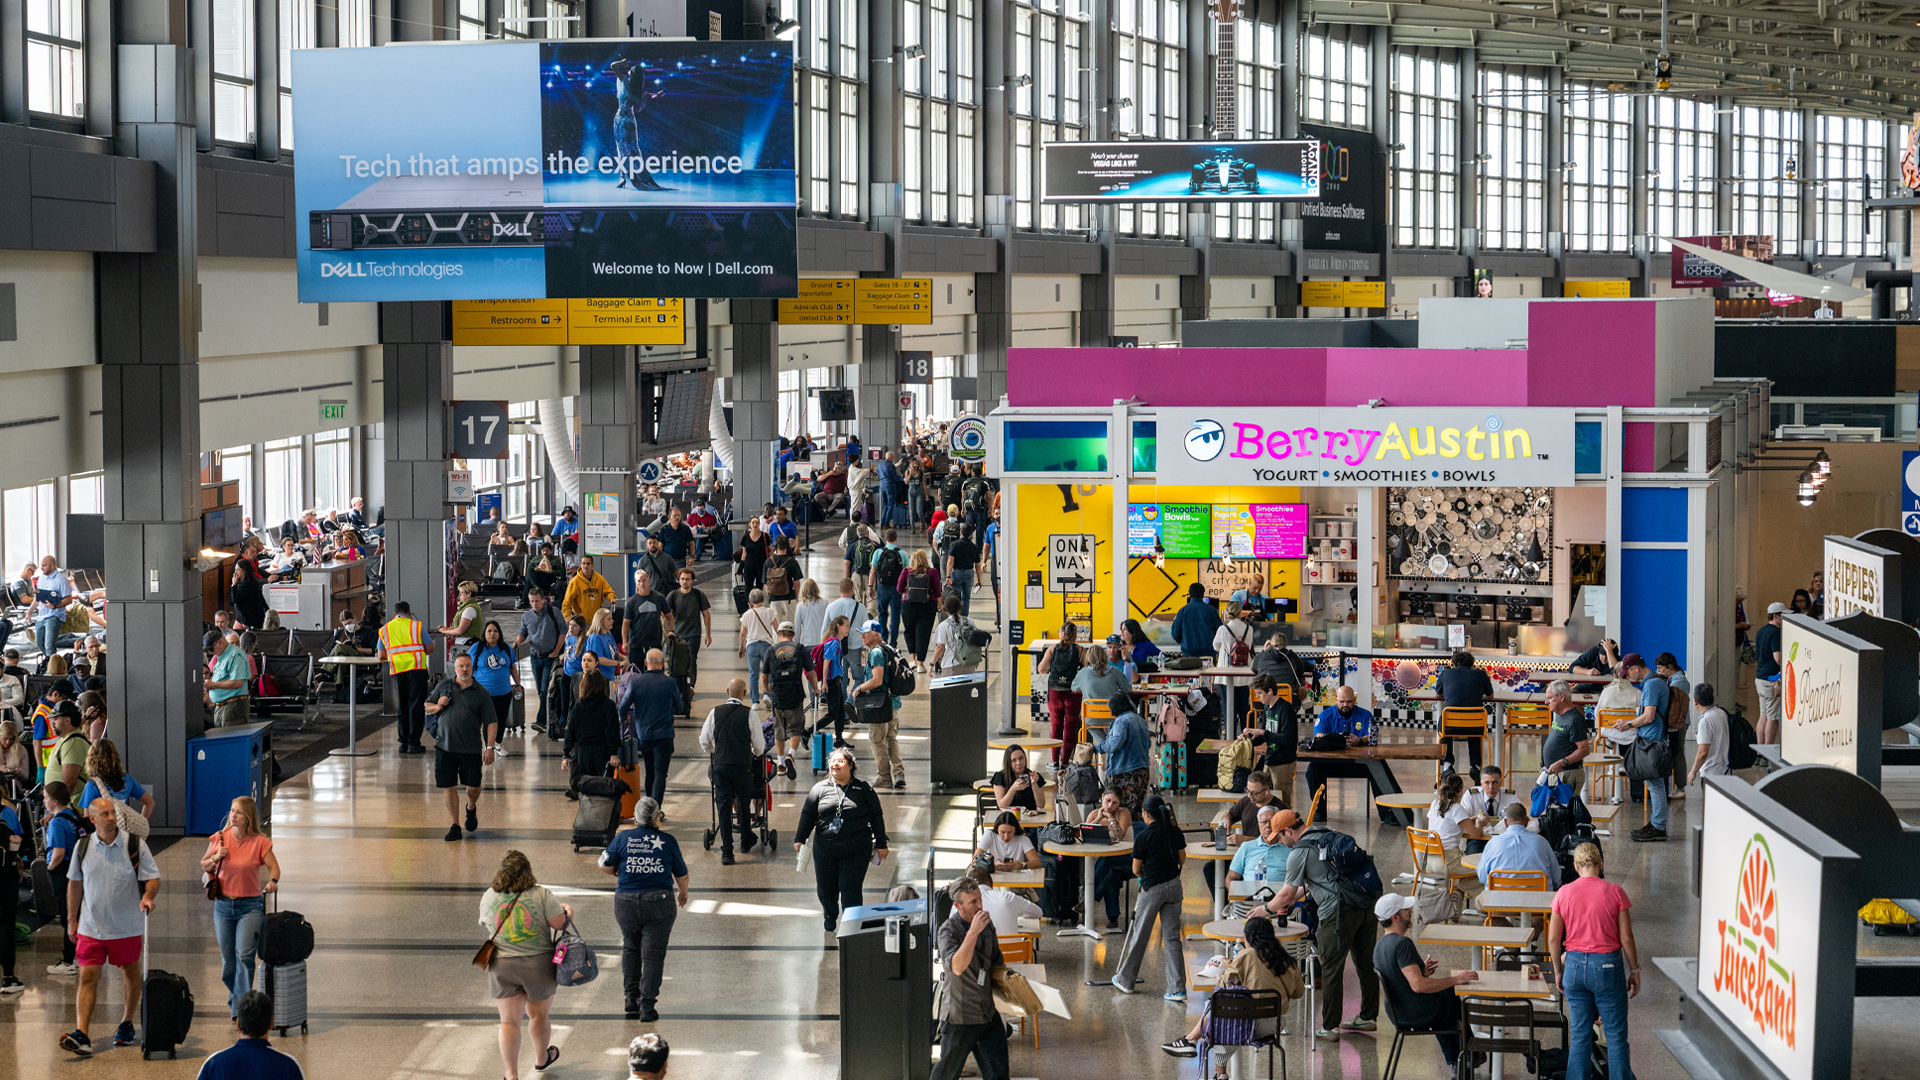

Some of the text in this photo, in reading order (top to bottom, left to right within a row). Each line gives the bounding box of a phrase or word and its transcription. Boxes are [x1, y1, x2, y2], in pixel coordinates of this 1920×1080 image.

[339, 150, 743, 181] Tech that amps the experience
[1308, 142, 1318, 196] BONVOY
[1327, 182, 1340, 190] ZOHO
[1301, 202, 1365, 220] Unified Business Software
[493, 222, 532, 236] DELL
[592, 262, 653, 275] Welcome
[657, 263, 670, 275] to
[674, 263, 703, 275] Now
[715, 262, 774, 275] Dell.com
[1308, 256, 1370, 270] BARBARA JORDAN TERMINAL
[586, 298, 651, 308] Baggage Claim
[491, 316, 536, 324] Restrooms
[593, 314, 651, 323] Terminal Exit
[906, 359, 928, 377] 18
[324, 405, 345, 418] EXIT
[462, 415, 500, 444] 17
[1230, 414, 1532, 466] BerryAustin
[1253, 469, 1496, 482] YOGURT SMOOTHIES BOWLS
[1164, 505, 1208, 513] Smoothie
[1128, 513, 1142, 521] wls
[1164, 513, 1191, 521] Bowls
[1056, 539, 1088, 552] ON
[1055, 556, 1088, 569] WAY
[1207, 561, 1262, 573] AUSTIN
[1833, 557, 1874, 605] HIPPIES
[1798, 663, 1842, 726] Peached
[1822, 728, 1853, 749] TORTILLA
[626, 857, 662, 865] PEOPLE
[626, 865, 664, 873] STRONG
